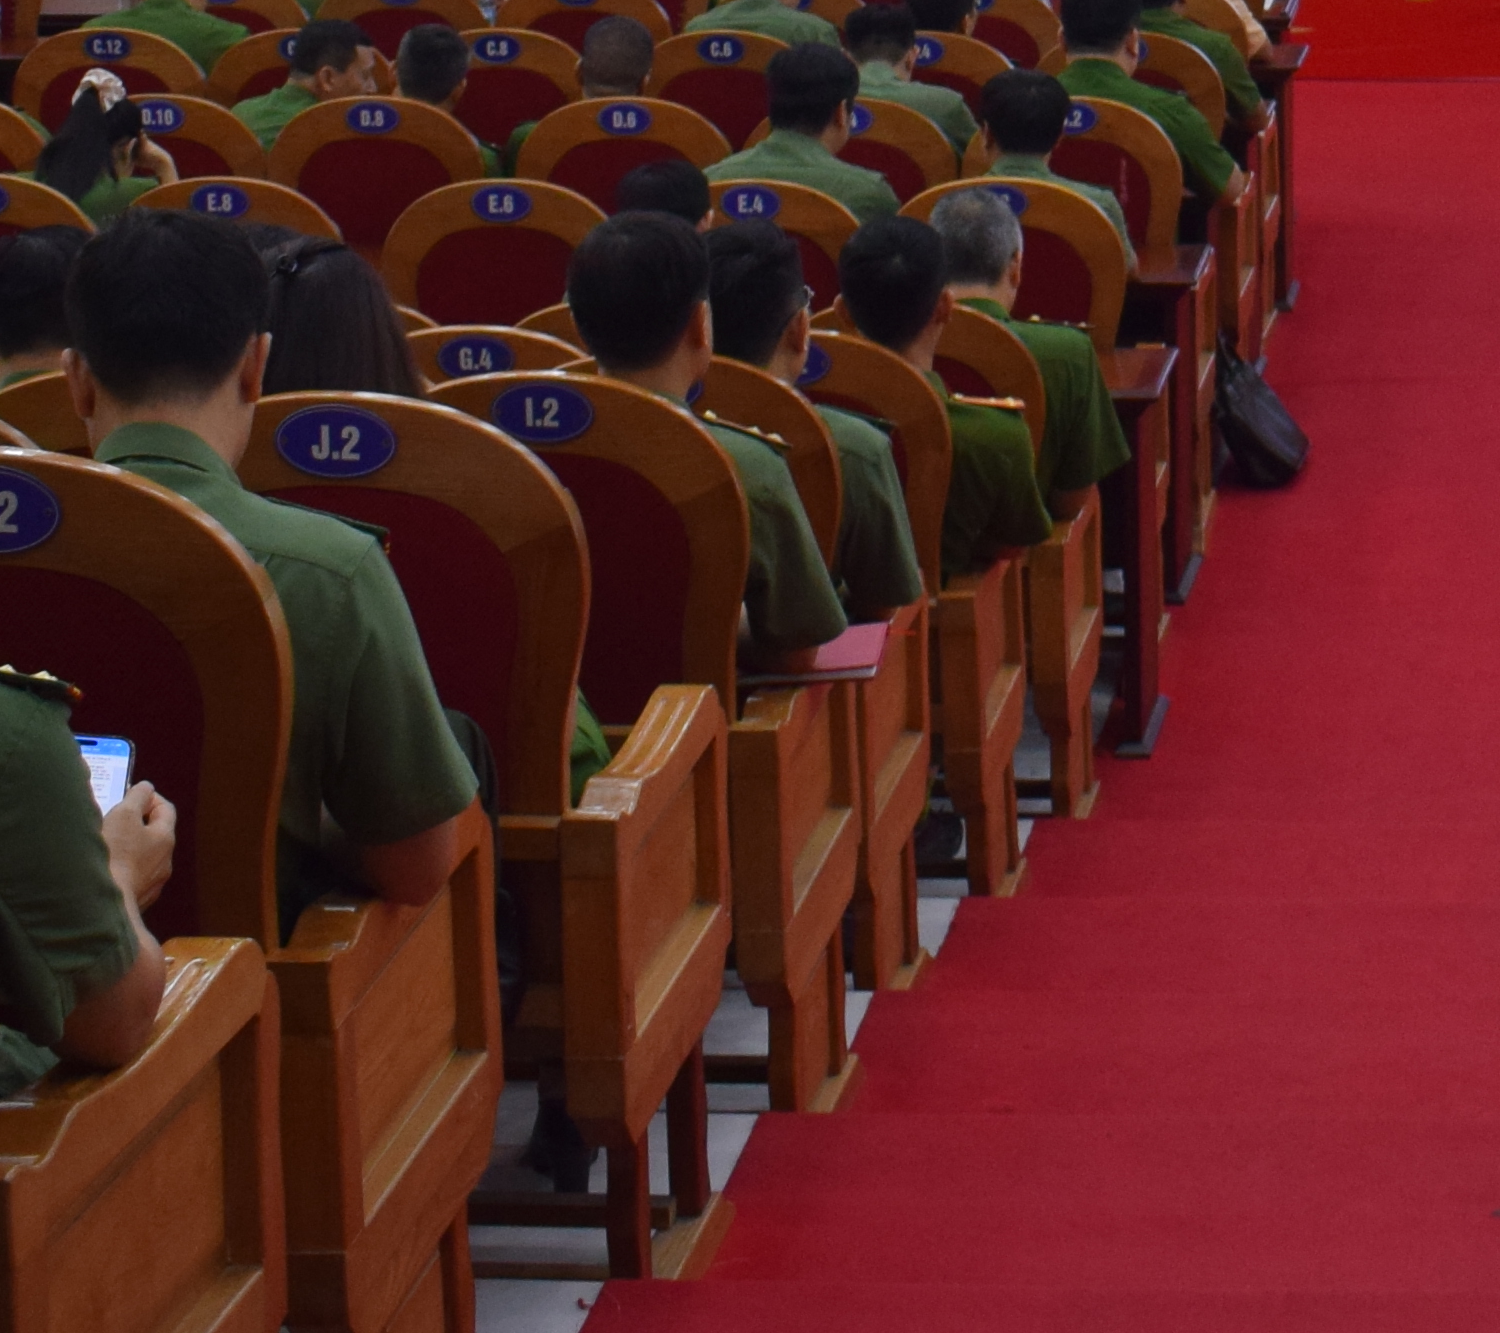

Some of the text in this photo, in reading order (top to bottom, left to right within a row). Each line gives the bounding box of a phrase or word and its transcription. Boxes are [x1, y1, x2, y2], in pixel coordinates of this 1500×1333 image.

[206, 193, 232, 211] E.8
[489, 195, 513, 213] E.6
[738, 194, 763, 213] E.4
[458, 347, 491, 371] G.4
[526, 398, 558, 427] I.2
[312, 425, 360, 460] J.2
